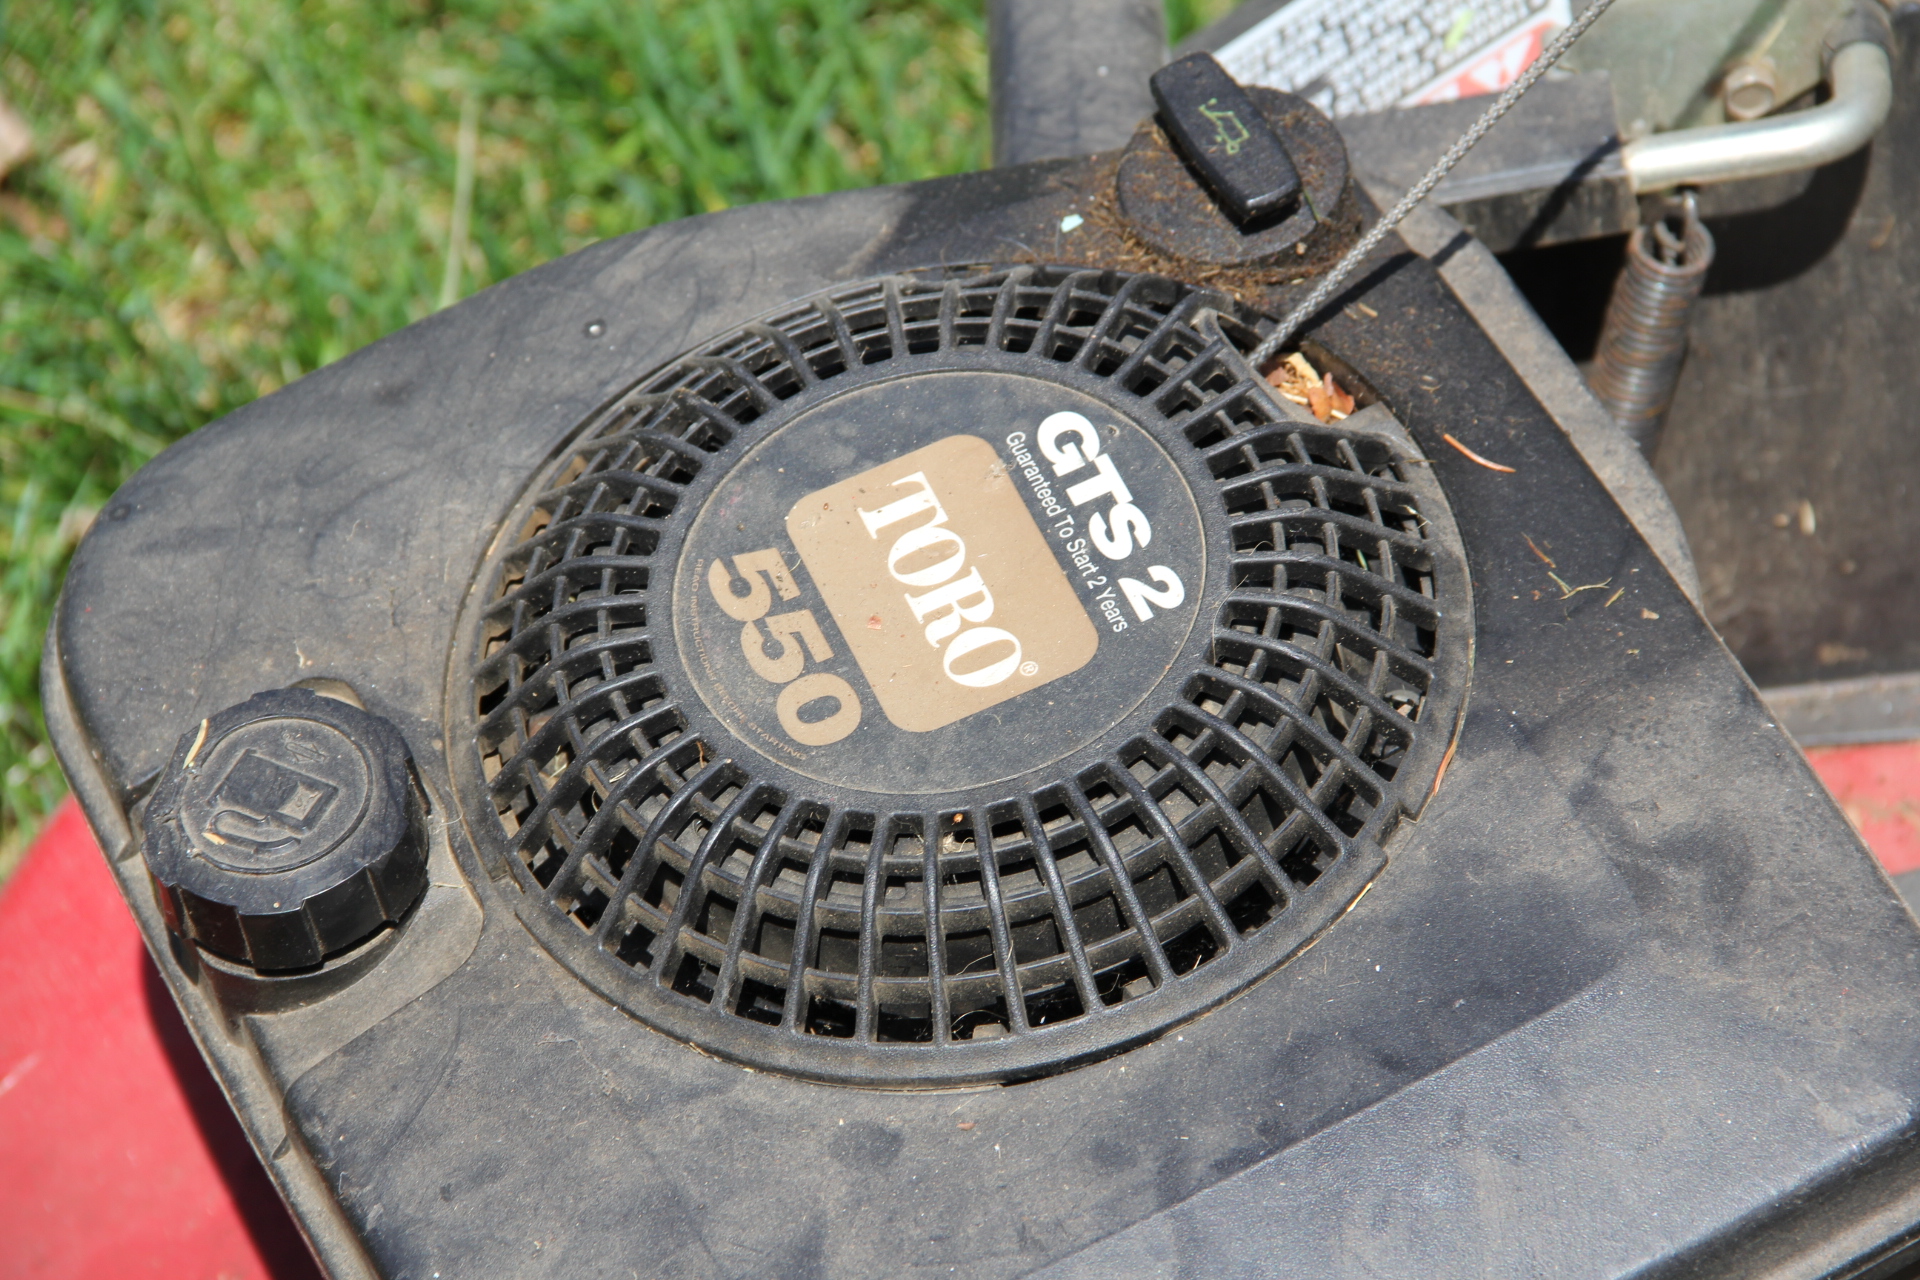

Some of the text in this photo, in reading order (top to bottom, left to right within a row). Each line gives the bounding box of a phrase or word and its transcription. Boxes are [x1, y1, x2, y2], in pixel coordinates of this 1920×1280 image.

[1006, 431, 1128, 633] Guaranteed To Start 2 Years
[1037, 411, 1185, 622] GTS 2
[691, 558, 704, 592] READ
[748, 722, 807, 761] STARTING
[708, 547, 862, 746] 550
